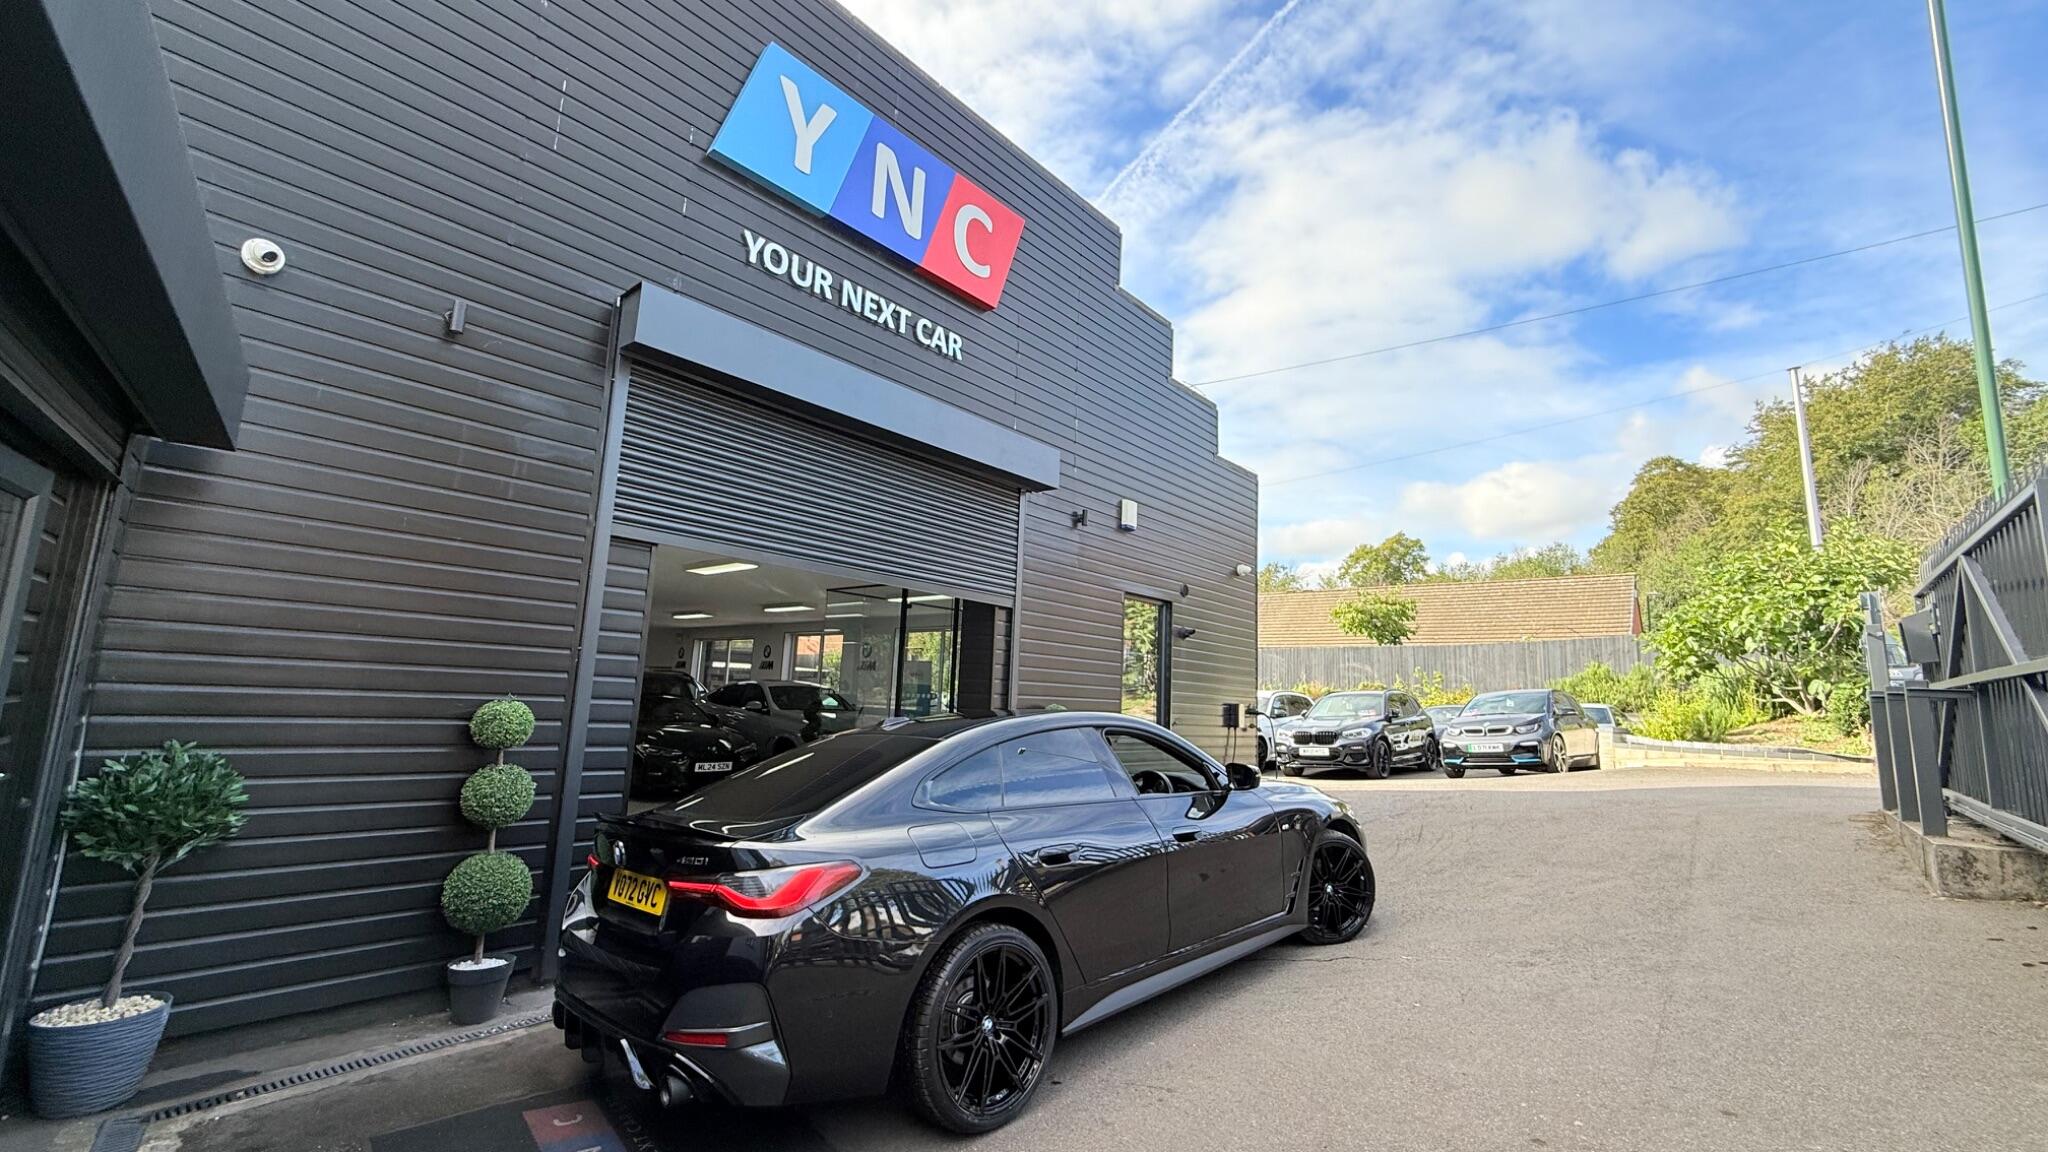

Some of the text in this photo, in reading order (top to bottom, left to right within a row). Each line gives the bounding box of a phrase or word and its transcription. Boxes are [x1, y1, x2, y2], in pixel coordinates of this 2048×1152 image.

[779, 74, 993, 279] YNC
[743, 229, 963, 361] YOUR NEXT CAR
